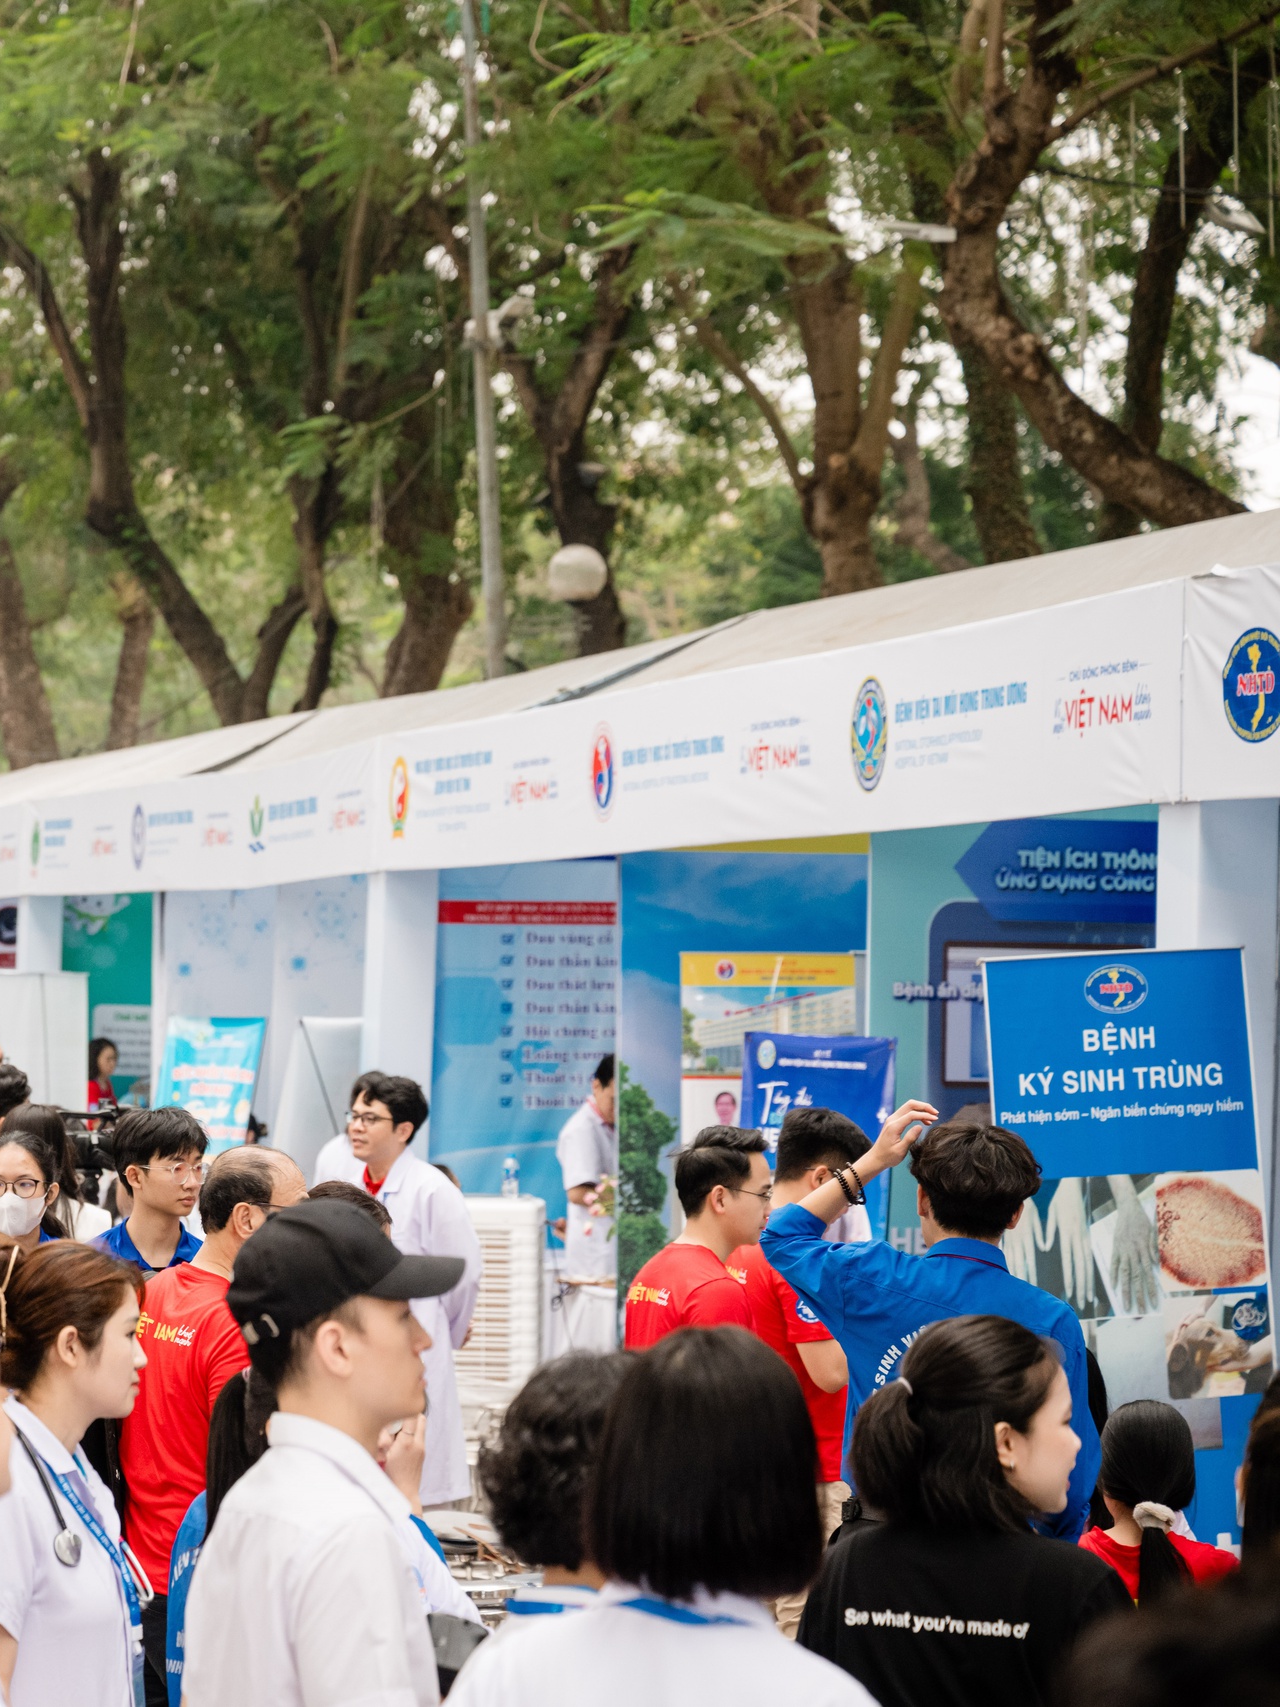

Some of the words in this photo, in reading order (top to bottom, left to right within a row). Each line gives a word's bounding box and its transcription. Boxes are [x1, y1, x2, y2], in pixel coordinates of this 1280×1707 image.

[1064, 688, 1095, 738] VIỆT
[1099, 693, 1133, 726] NAM
[1018, 846, 1061, 871] TIỆN
[1065, 847, 1099, 869] ÍCH
[1100, 870, 1155, 892] CÔNG
[1082, 1022, 1156, 1056] BỆNH
[1019, 1066, 1054, 1096] KÝ
[1062, 1068, 1125, 1094] SINH
[1132, 1059, 1223, 1092] TRÙNG
[1000, 1110, 1026, 1125] Phát
[1028, 1109, 1052, 1125] hiện
[1054, 1108, 1080, 1122] sớm
[1091, 1105, 1121, 1122] Ngăn
[1123, 1102, 1147, 1118] biến
[1149, 1102, 1185, 1118] chứng
[1186, 1102, 1214, 1116] nguy
[1216, 1096, 1245, 1112] hiểm
[874, 1344, 903, 1386] SINH
[844, 1607, 870, 1627] See
[871, 1608, 912, 1629] what
[966, 1618, 1012, 1638] made
